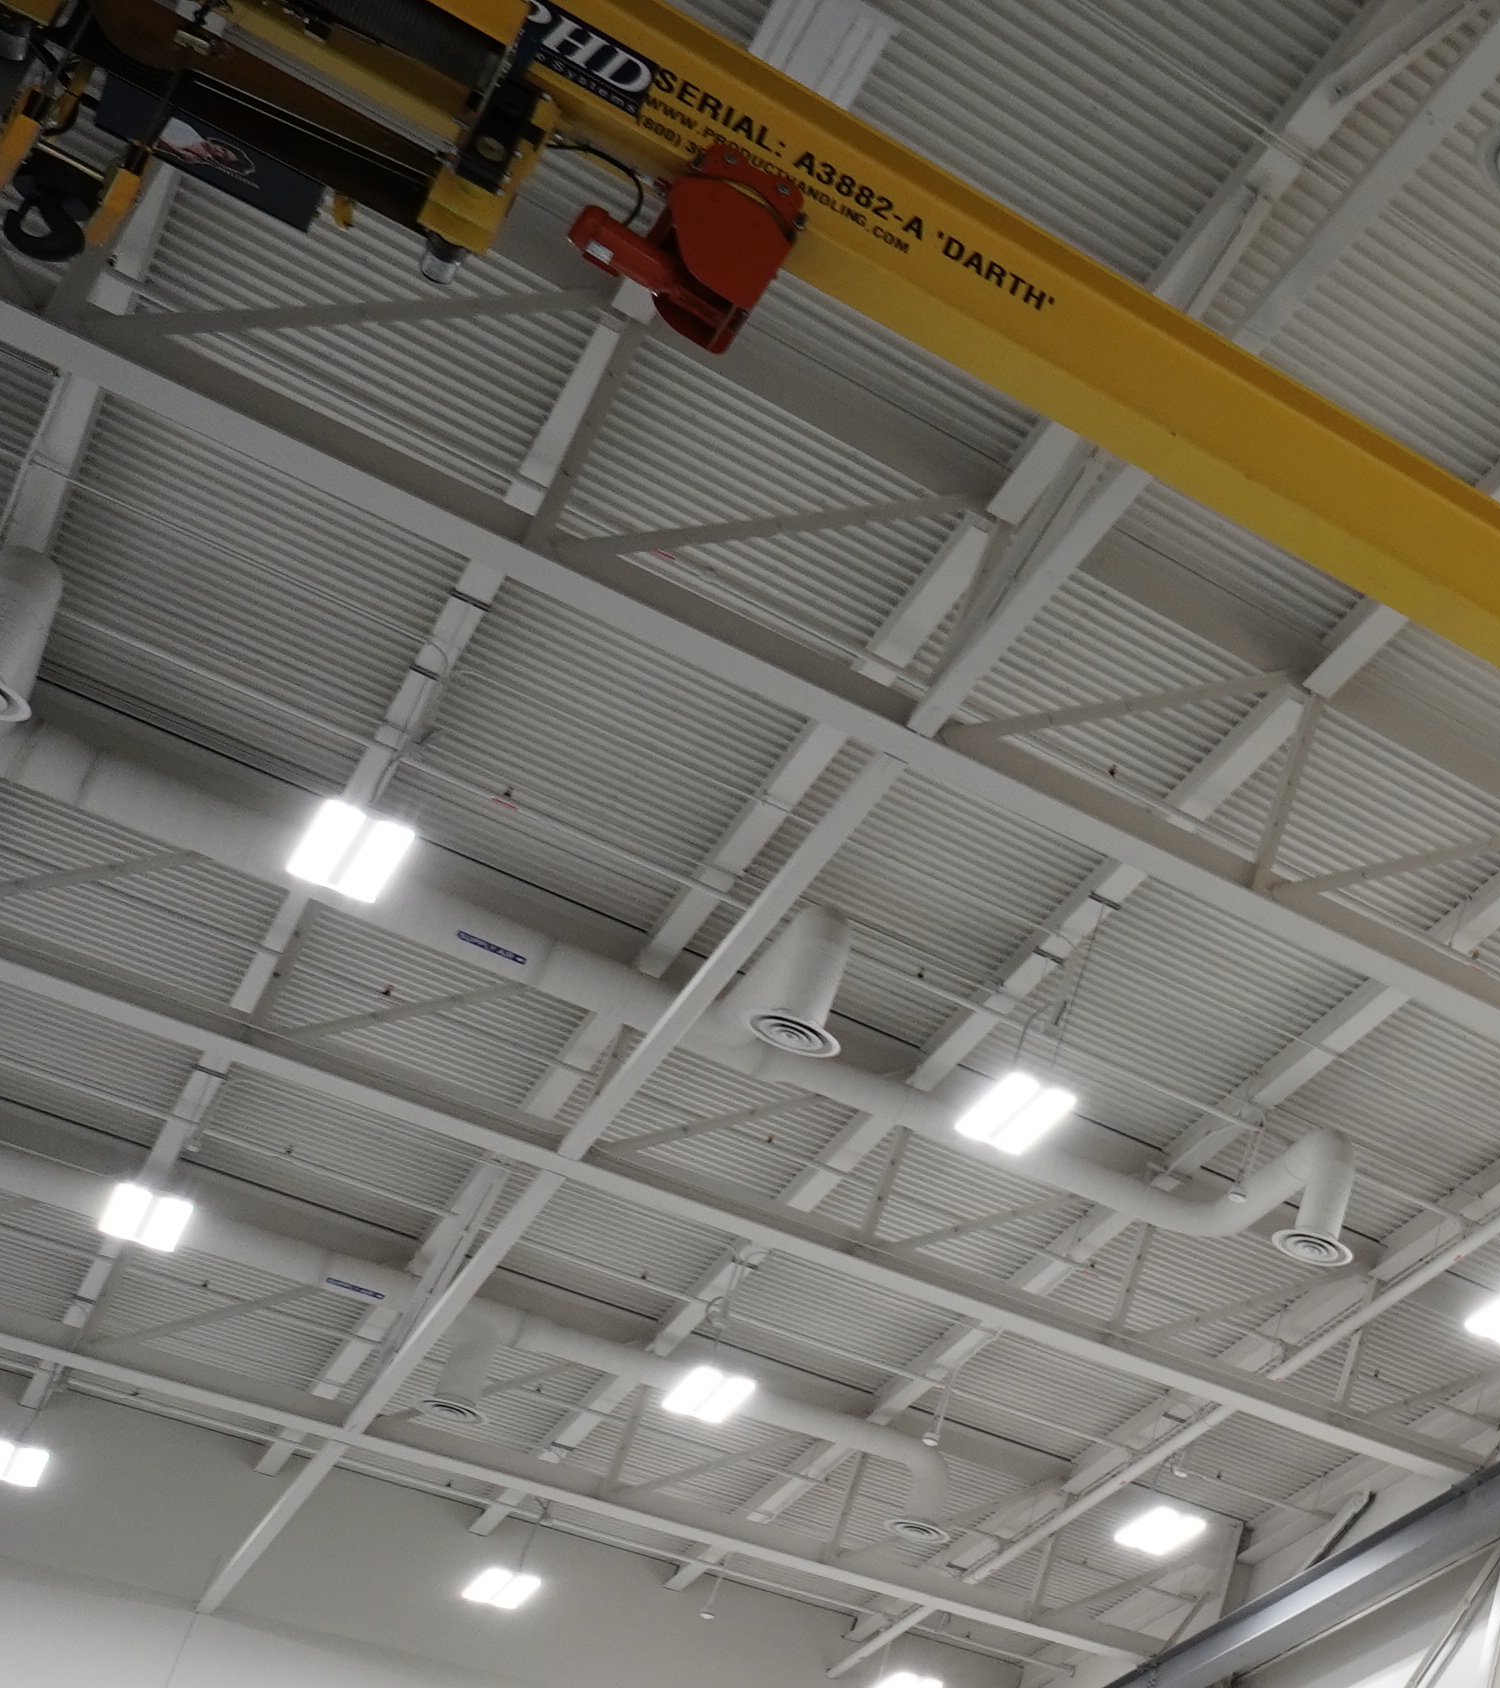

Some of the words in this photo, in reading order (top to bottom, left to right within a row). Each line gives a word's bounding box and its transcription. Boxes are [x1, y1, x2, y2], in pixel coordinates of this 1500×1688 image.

[552, 59, 638, 113] Systems
[636, 114, 683, 147] (800)
[653, 69, 787, 158] SERIAL:
[793, 151, 924, 240] A3882-A
